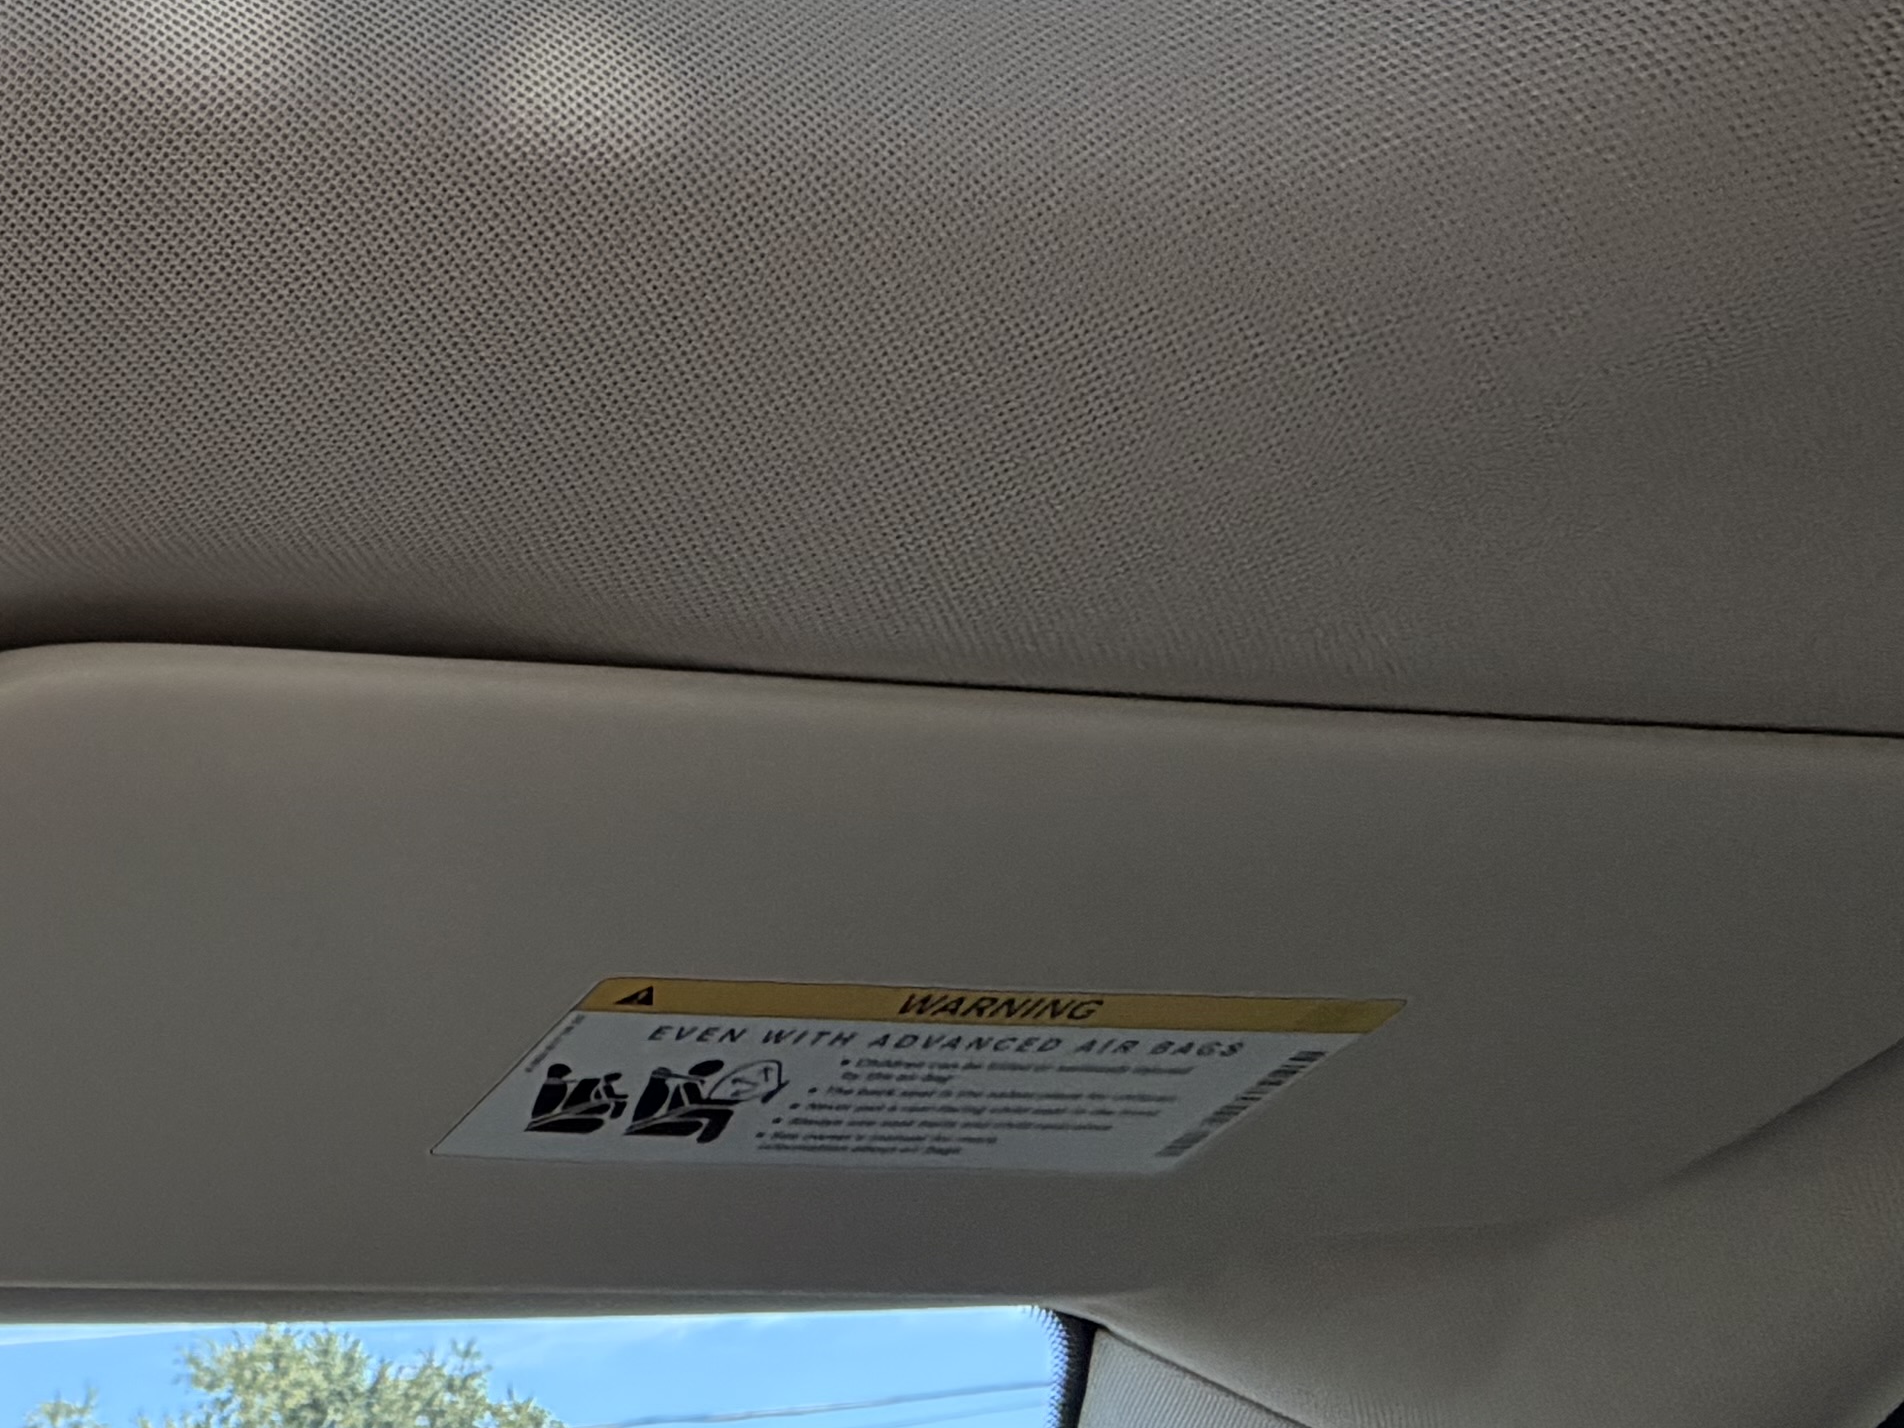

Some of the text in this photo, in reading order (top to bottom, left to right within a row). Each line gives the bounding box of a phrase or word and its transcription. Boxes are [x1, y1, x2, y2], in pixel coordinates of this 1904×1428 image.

[899, 993, 1104, 1021] WARNING
[648, 1025, 1245, 1057] EVEN WITH ADVANCED AIR BAGS
